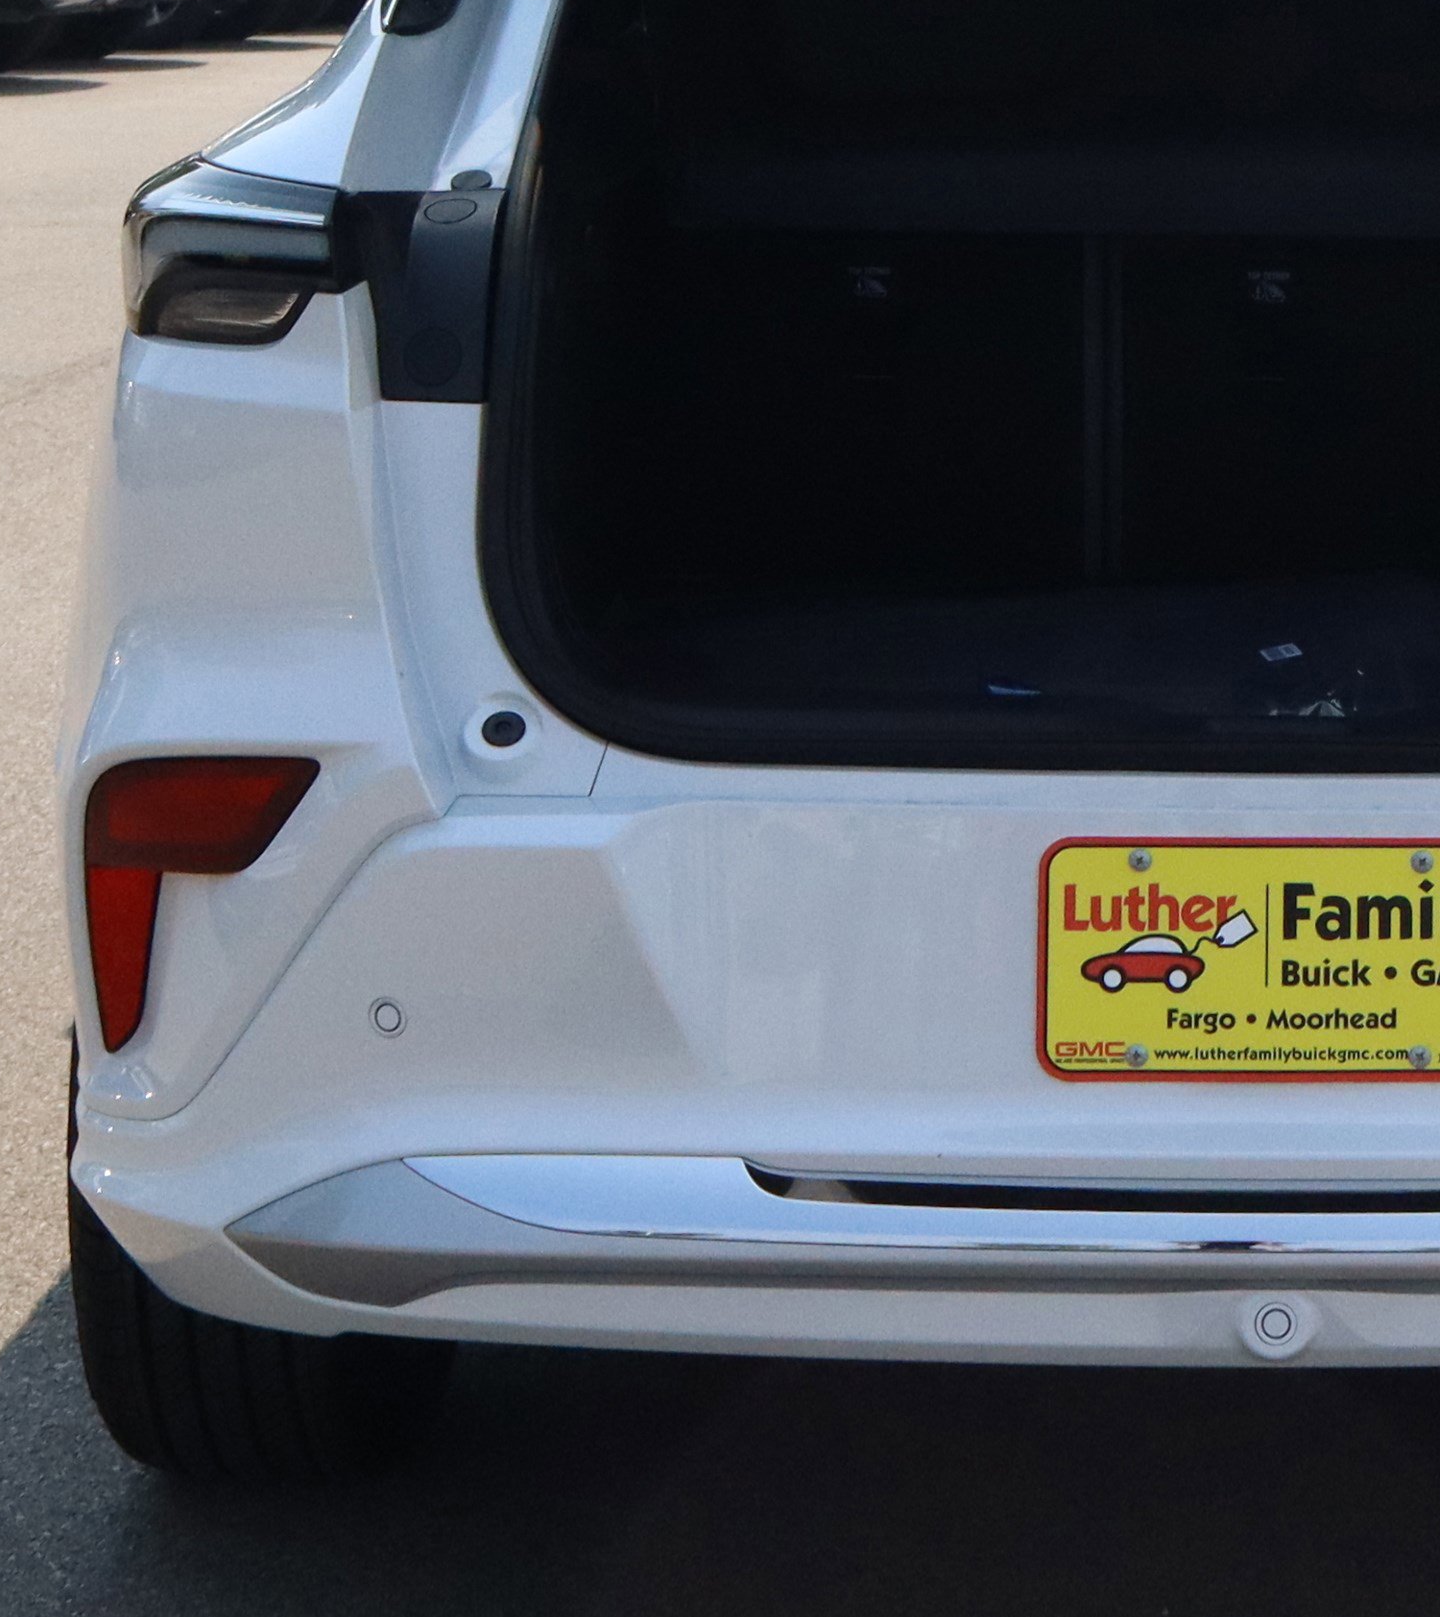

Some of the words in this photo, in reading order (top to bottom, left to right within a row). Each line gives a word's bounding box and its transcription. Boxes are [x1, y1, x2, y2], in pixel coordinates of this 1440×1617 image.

[1064, 882, 1238, 933] Luther
[1281, 957, 1372, 987] Buick
[1166, 1008, 1237, 1035] Fargo
[1266, 1007, 1398, 1030] Moorhead
[1055, 1041, 1126, 1057] GMC
[1153, 1046, 1410, 1064] www.lutherfamilybuickgmc.com
